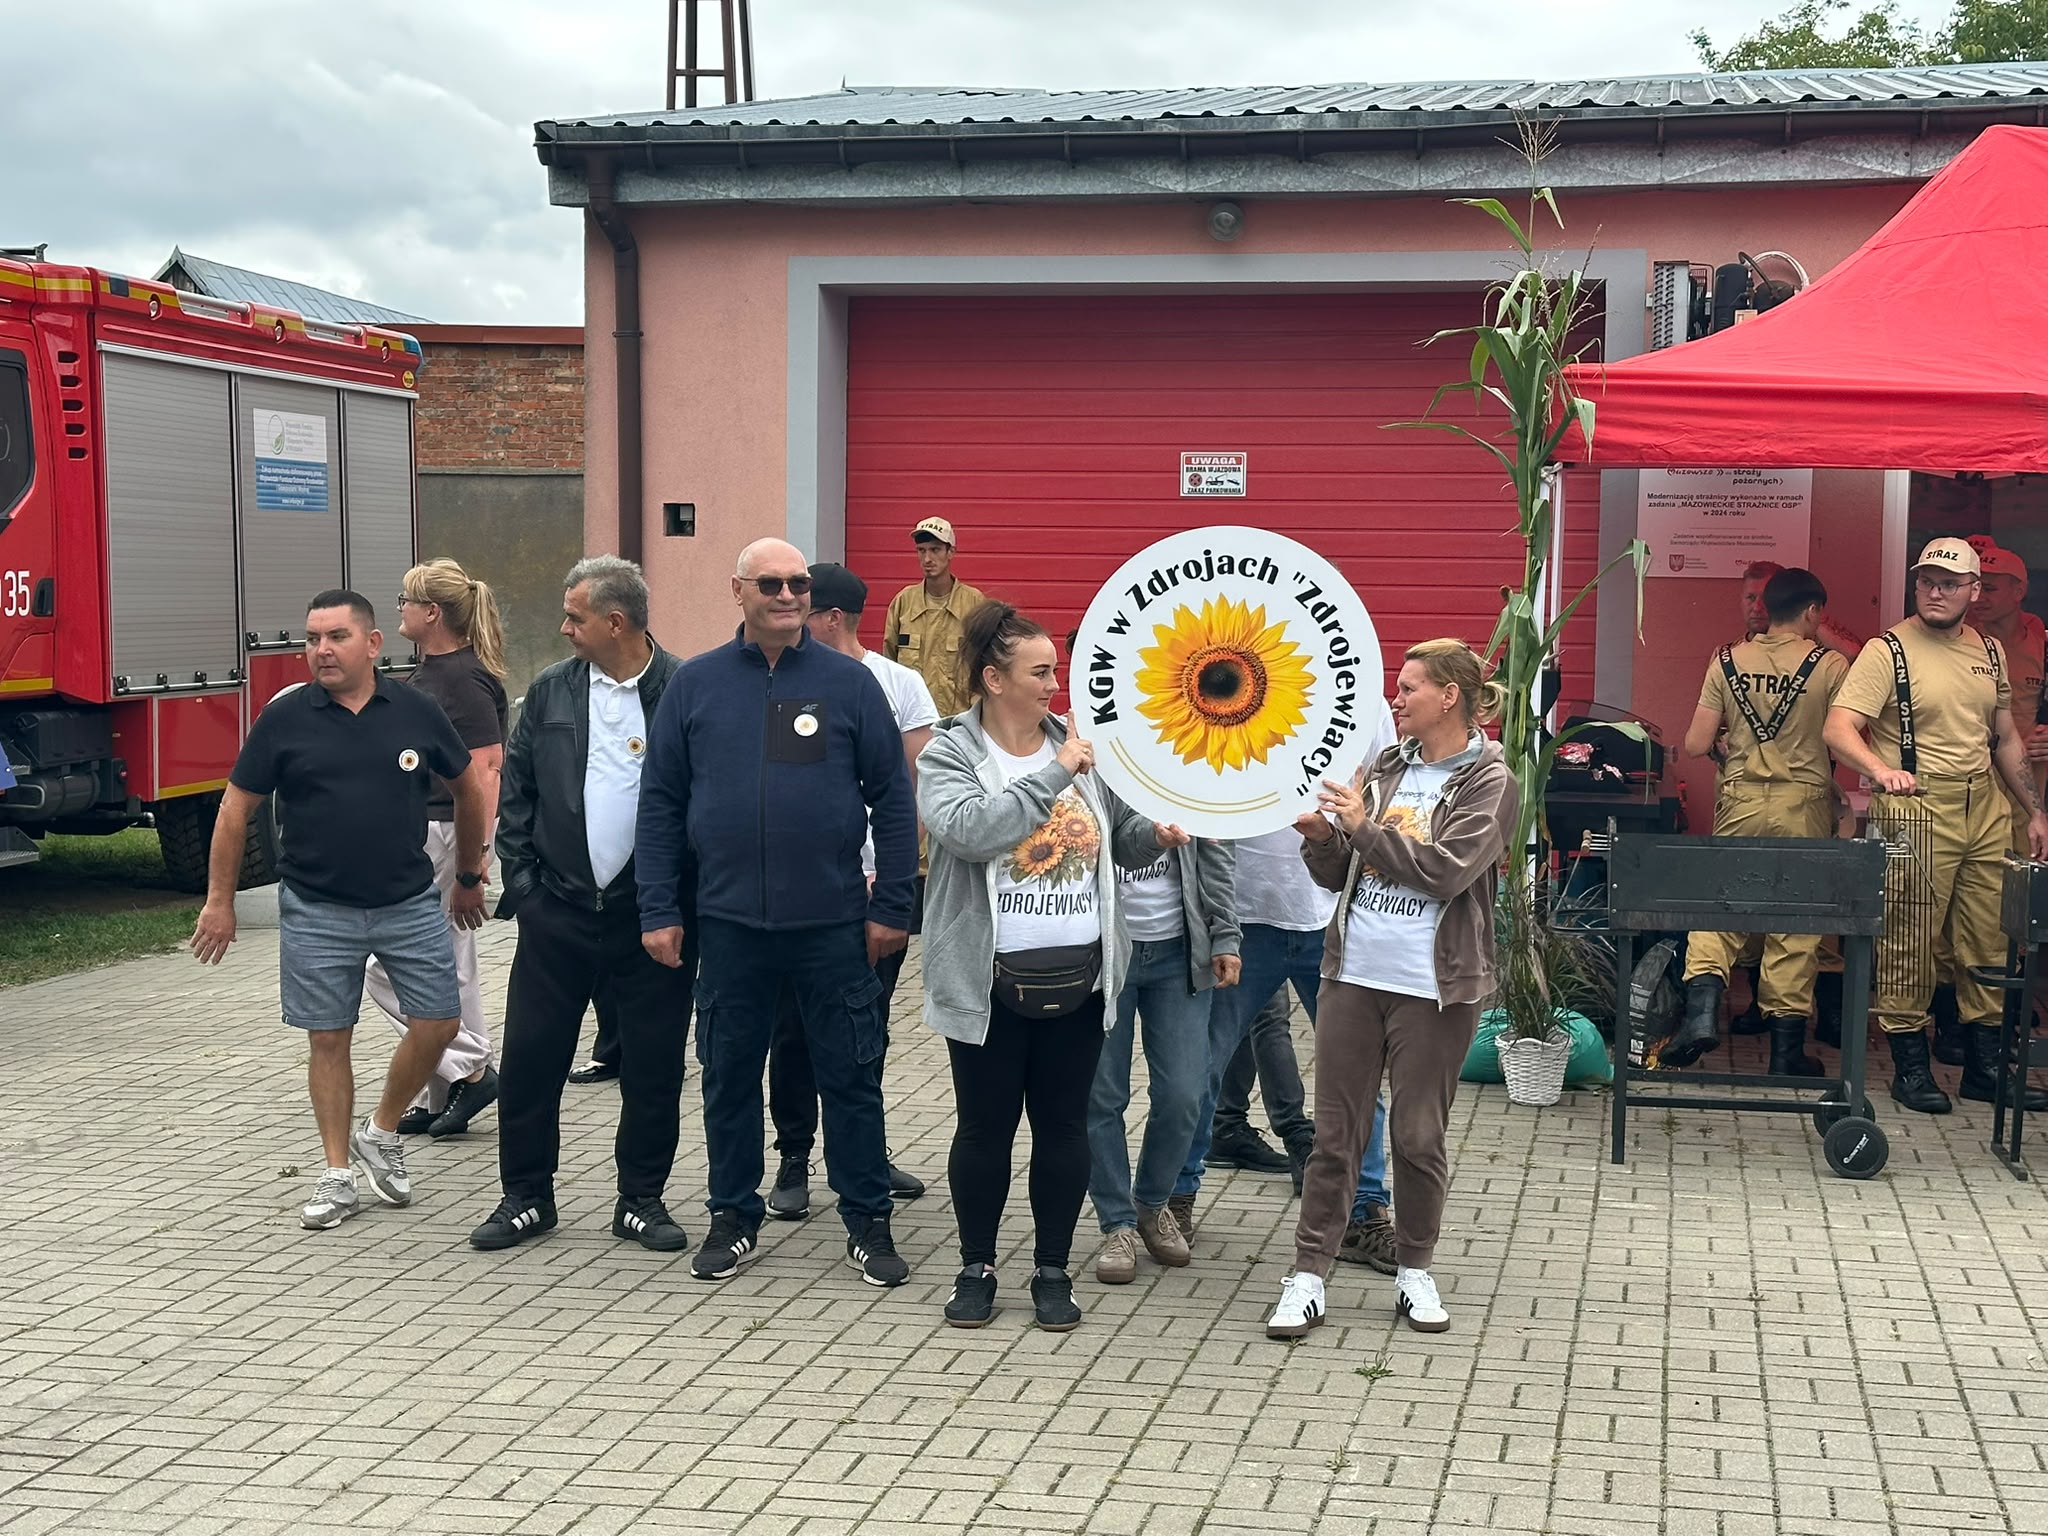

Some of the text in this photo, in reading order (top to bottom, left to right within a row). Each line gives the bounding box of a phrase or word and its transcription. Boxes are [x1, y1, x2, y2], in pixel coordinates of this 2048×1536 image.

[1191, 457, 1237, 465] UWAGA
[1647, 493, 1694, 501] Modernizację
[1695, 493, 1728, 501] strażnicy
[0, 570, 30, 617] 35
[1087, 644, 1119, 726] KGW
[1106, 609, 1132, 637] w
[1124, 548, 1280, 612] Zdrojach
[1738, 672, 1807, 694] STRA
